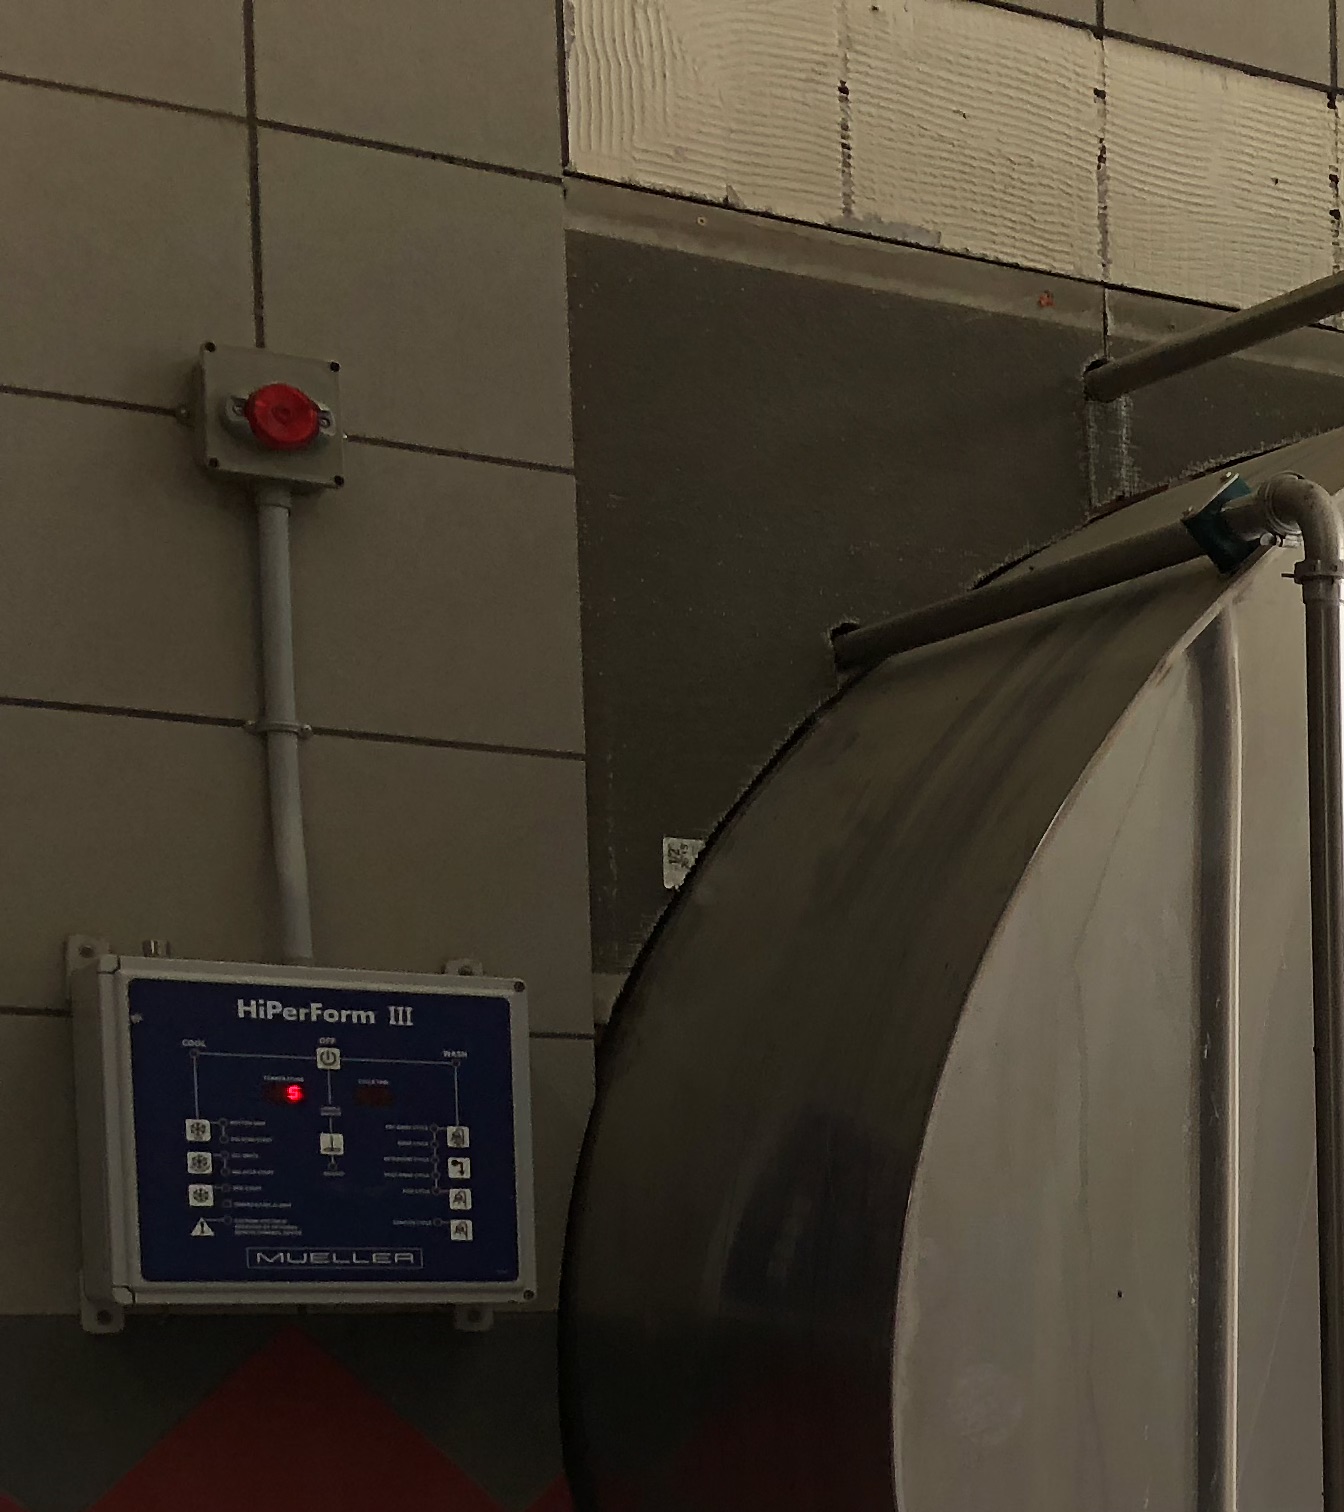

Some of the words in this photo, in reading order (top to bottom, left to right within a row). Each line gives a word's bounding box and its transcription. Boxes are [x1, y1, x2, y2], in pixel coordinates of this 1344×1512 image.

[237, 997, 375, 1025] HiPerForm
[388, 1005, 413, 1027] III
[255, 1251, 414, 1266] MUELLER
